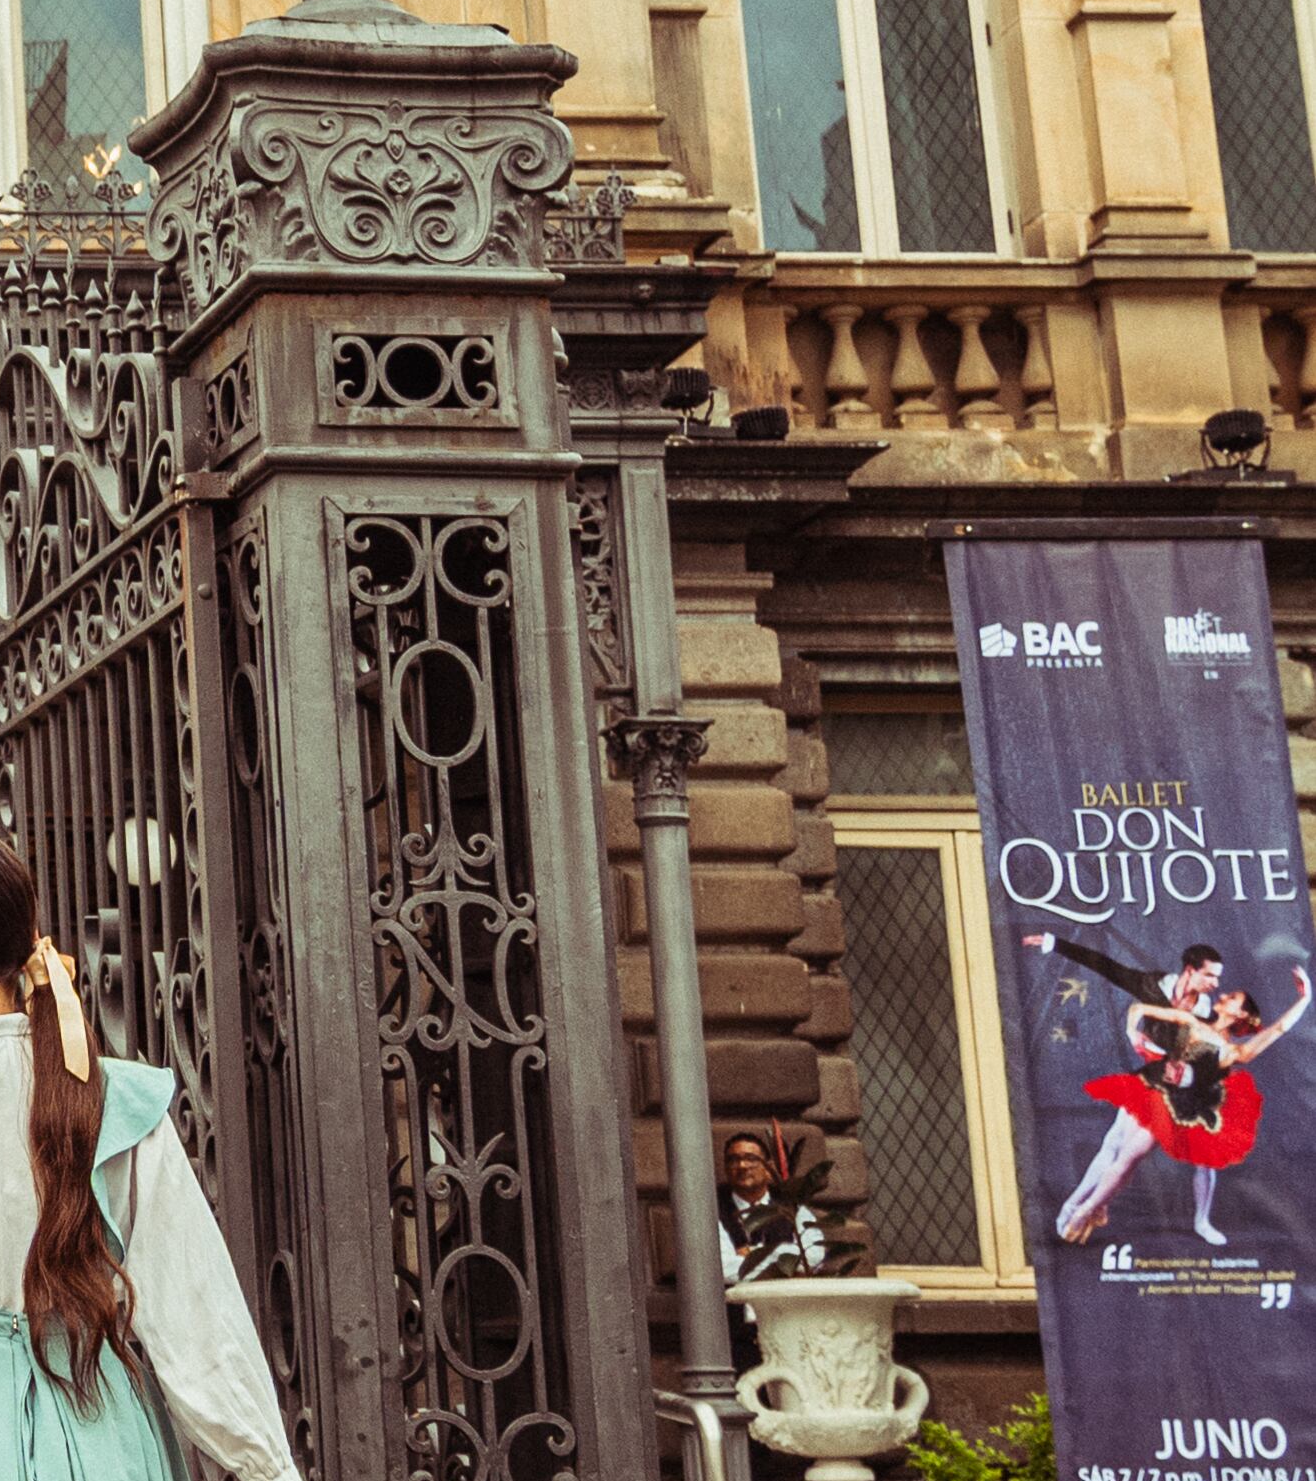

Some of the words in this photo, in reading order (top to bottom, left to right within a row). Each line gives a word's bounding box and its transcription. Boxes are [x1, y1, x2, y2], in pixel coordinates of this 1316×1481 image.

[1022, 621, 1102, 657] BAC
[1026, 657, 1104, 669] PRESENTA
[1081, 780, 1189, 807] BALLET
[1072, 806, 1206, 851] DON
[999, 837, 1298, 924] QUIJOTE
[1155, 1418, 1288, 1460] JUNIO
